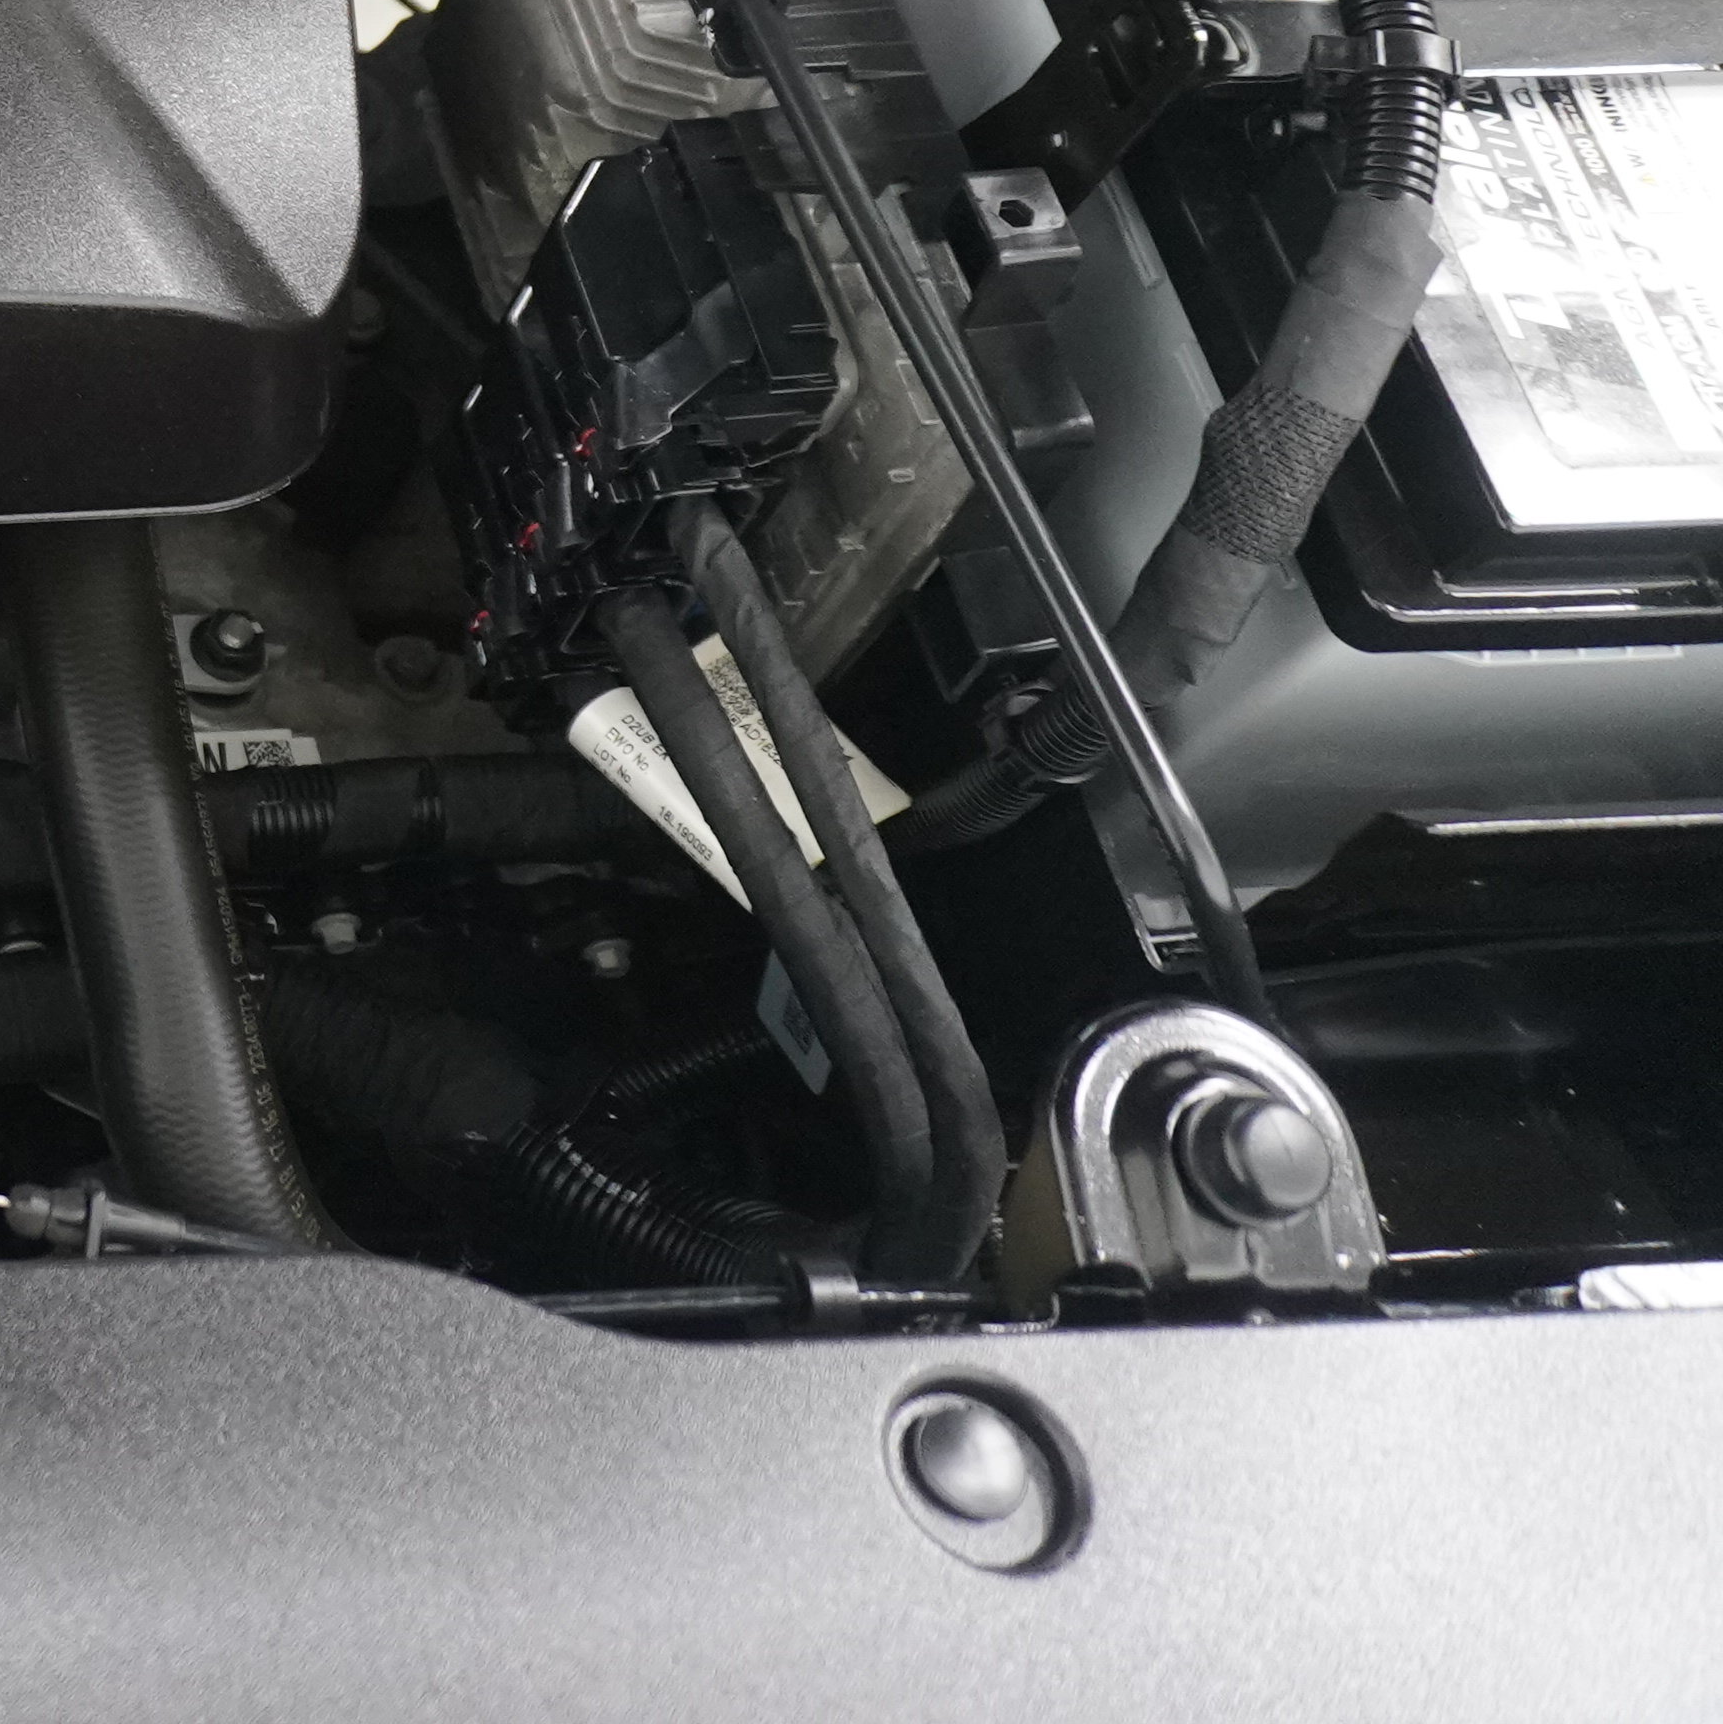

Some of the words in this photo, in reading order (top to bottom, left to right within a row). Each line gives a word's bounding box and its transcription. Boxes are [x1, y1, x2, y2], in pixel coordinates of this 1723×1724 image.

[1573, 136, 1608, 176] 1000
[592, 743, 617, 767] LOT
[603, 727, 635, 755] EWO
